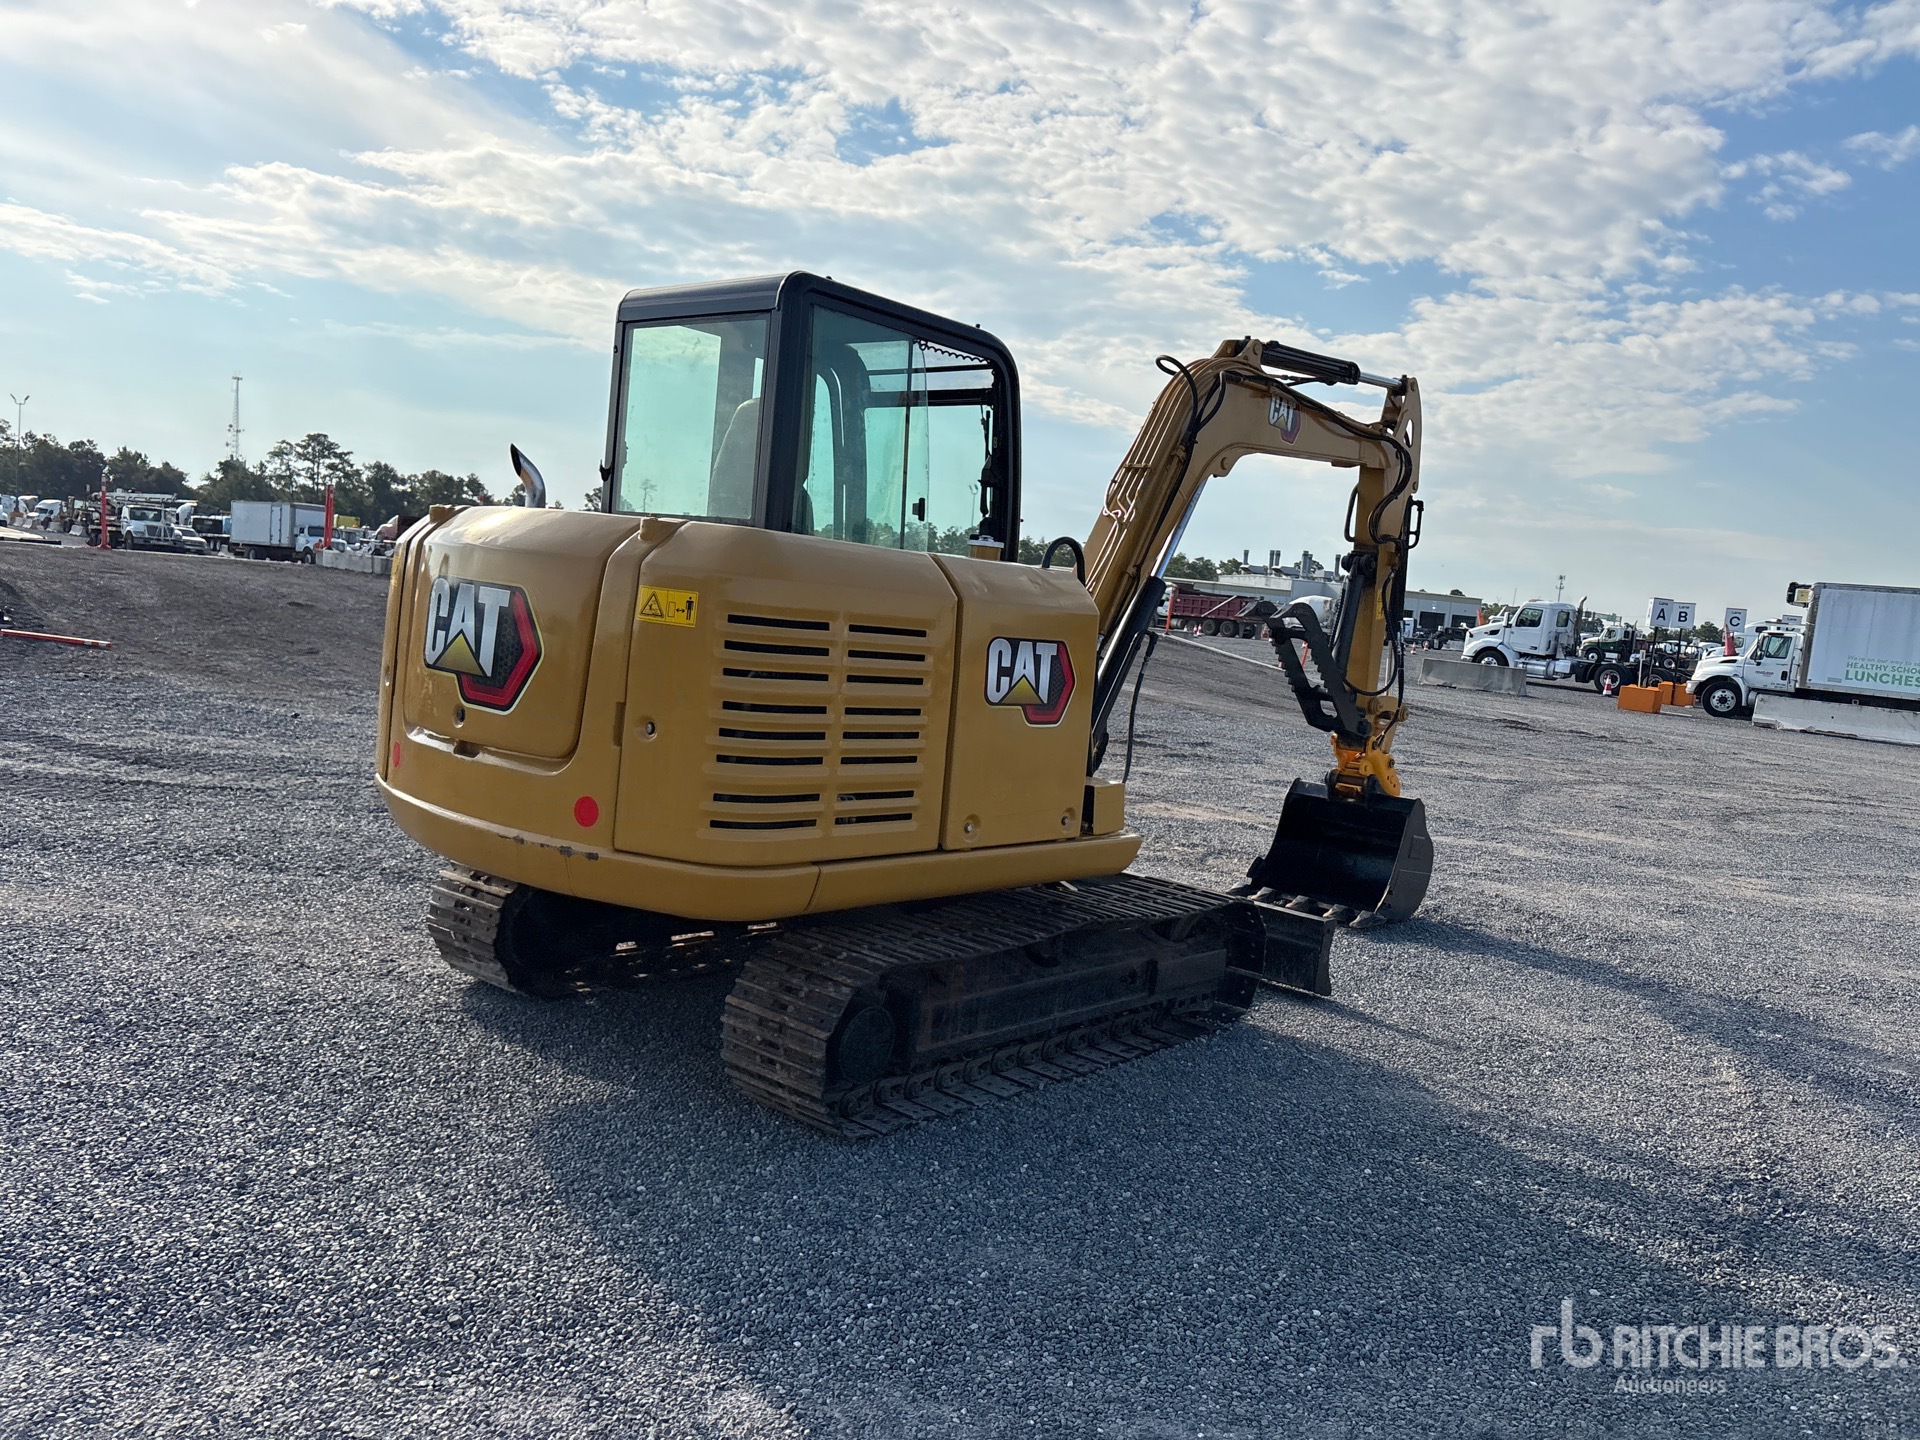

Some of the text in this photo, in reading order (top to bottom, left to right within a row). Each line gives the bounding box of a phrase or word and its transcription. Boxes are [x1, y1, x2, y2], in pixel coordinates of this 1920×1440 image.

[1656, 608, 1666, 621] A
[1678, 611, 1688, 622] B
[425, 577, 511, 677] CAT
[1729, 616, 1741, 627] C
[987, 638, 1058, 704] CAT
[1846, 662, 1889, 672] HEALTHY
[1844, 670, 1920, 687] LUNCHES
